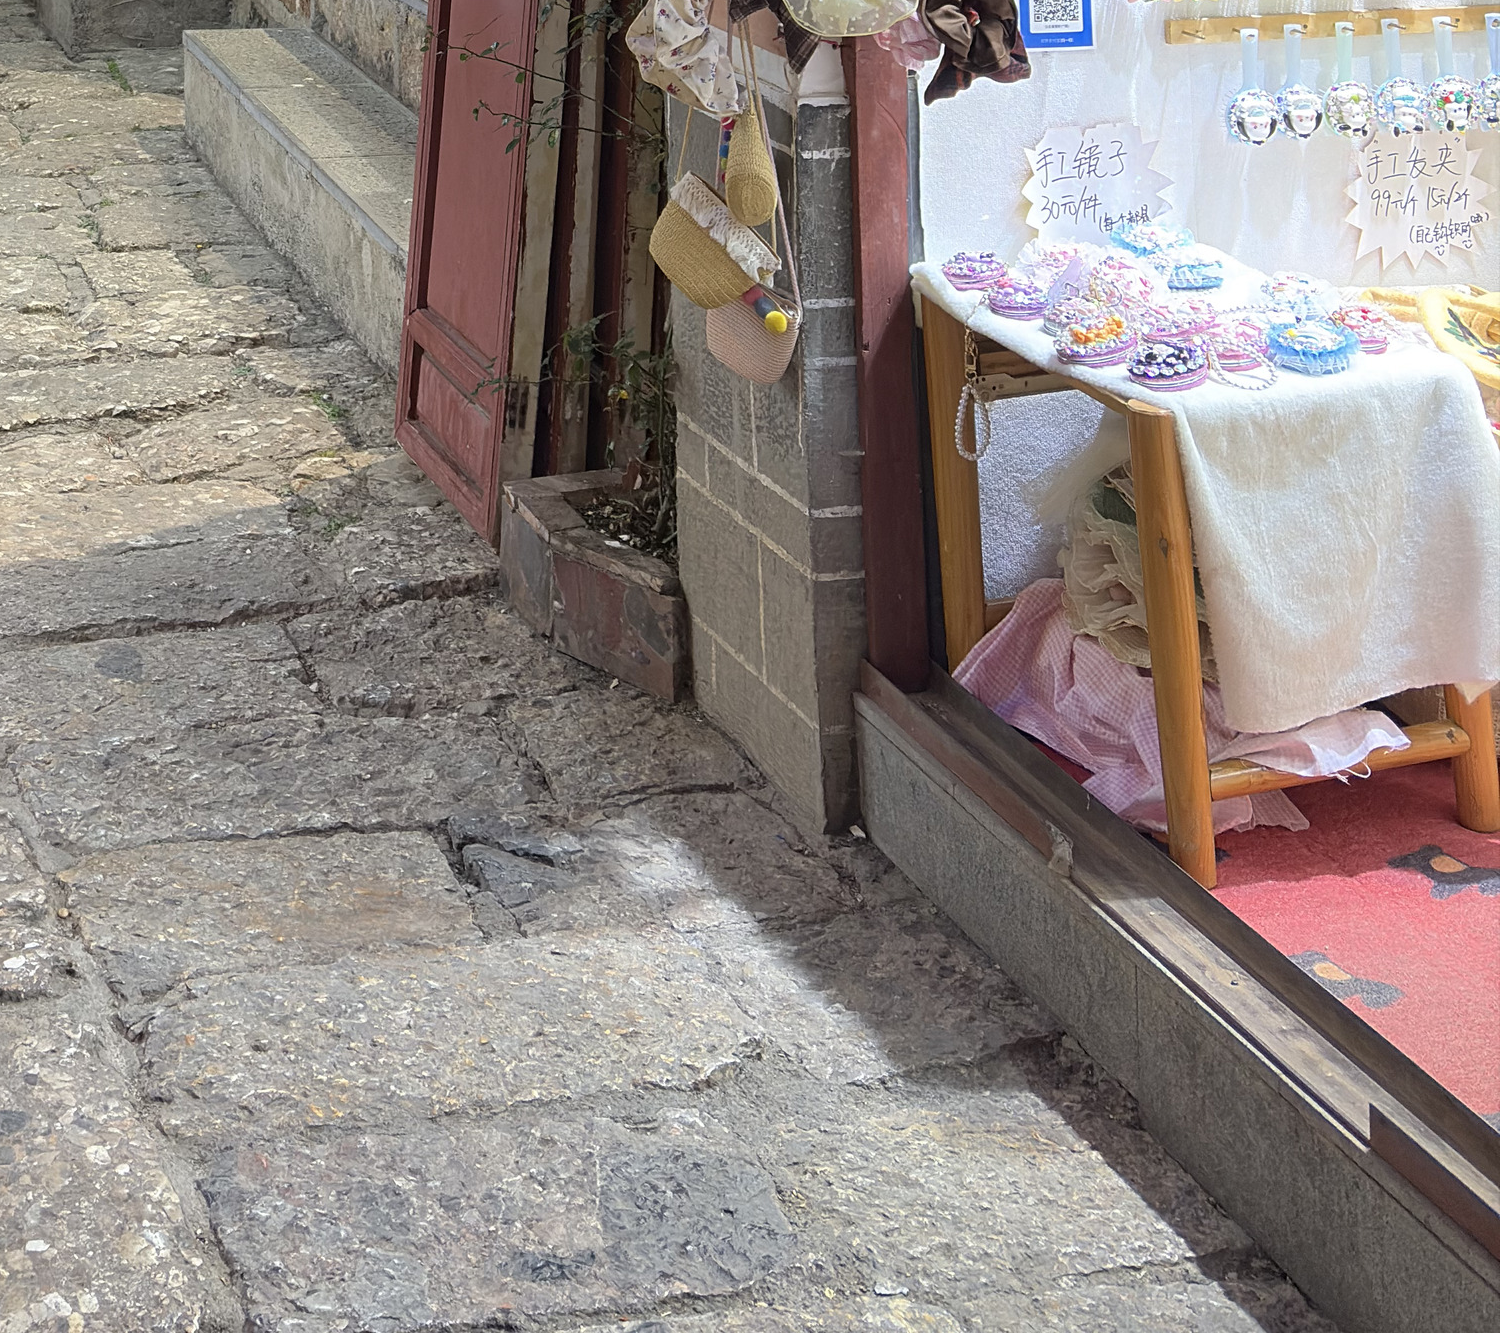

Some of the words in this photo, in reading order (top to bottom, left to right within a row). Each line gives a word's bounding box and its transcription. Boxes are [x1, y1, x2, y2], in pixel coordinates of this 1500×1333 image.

[1036, 138, 1128, 189] 手工镜子
[1041, 186, 1103, 225] 30元/件
